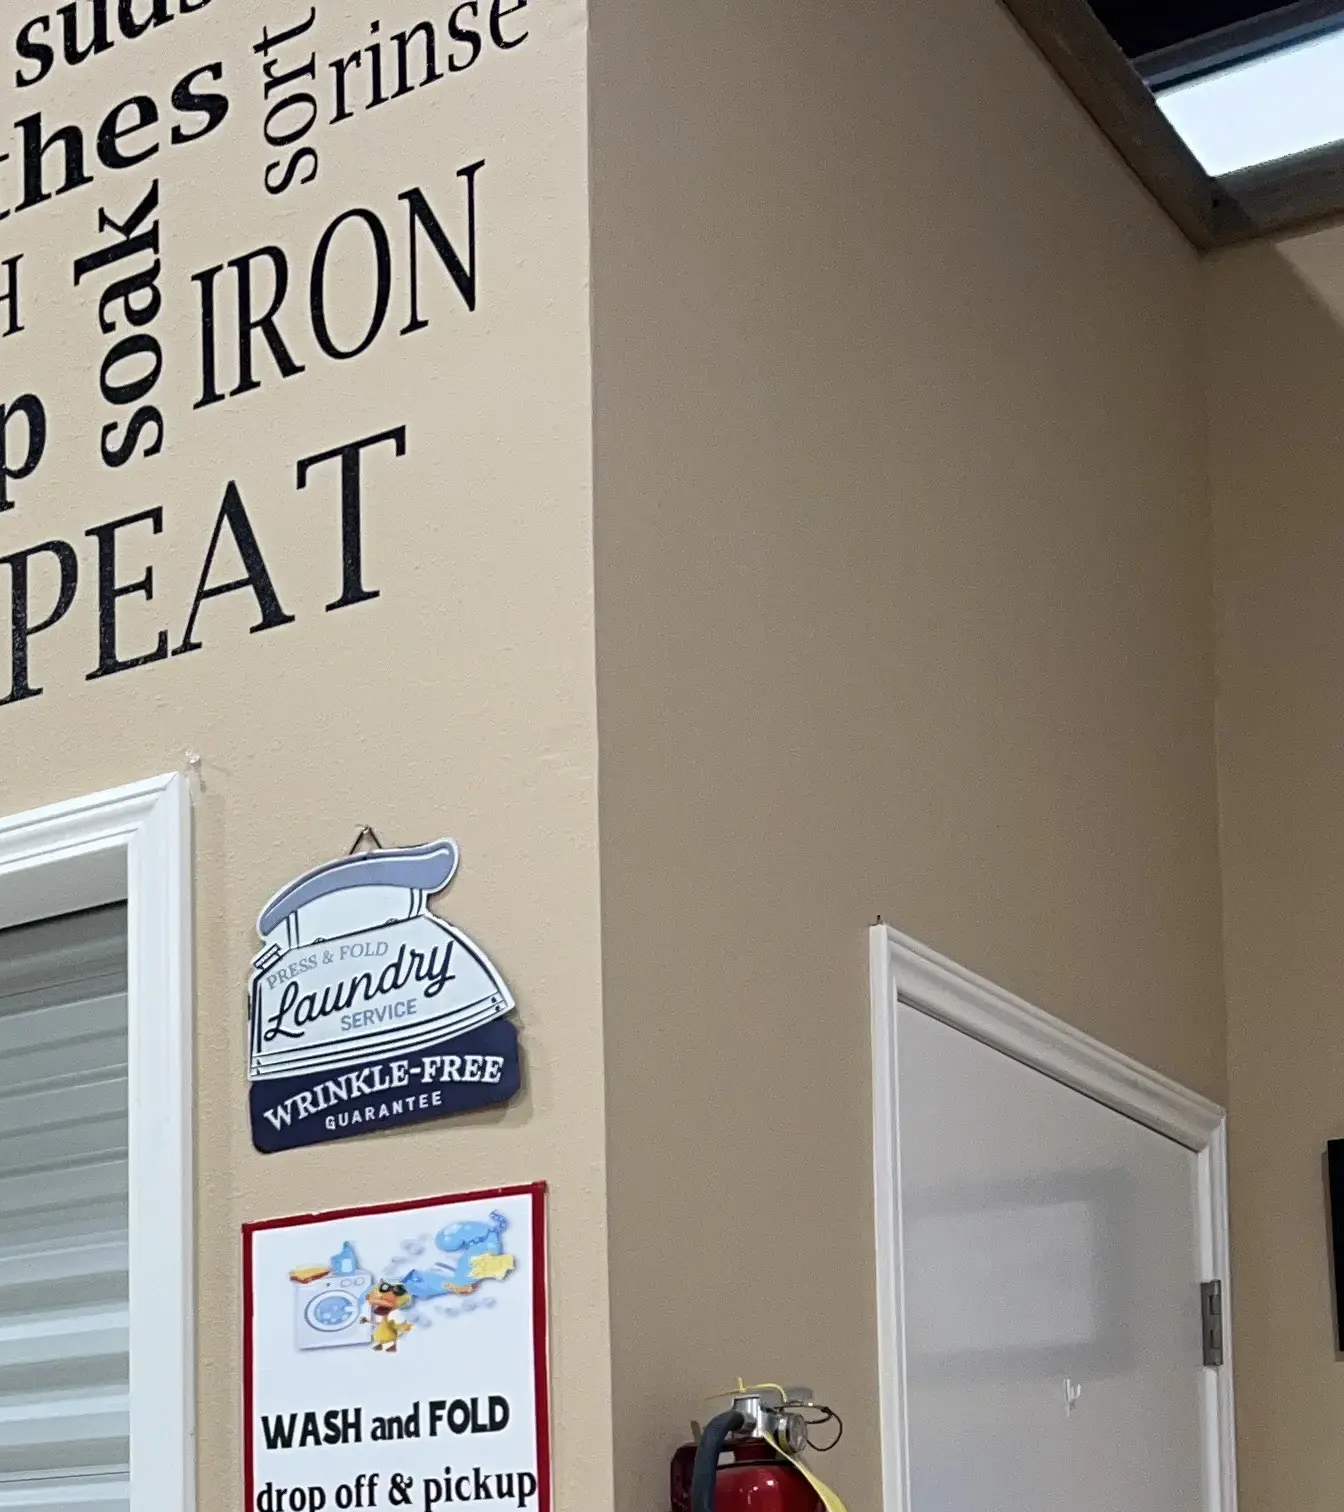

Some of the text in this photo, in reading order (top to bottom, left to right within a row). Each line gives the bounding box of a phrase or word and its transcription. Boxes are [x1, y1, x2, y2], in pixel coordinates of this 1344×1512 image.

[15, 0, 213, 88] su
[329, 0, 529, 125] rinse
[253, 3, 318, 195] sort
[74, 179, 164, 468] soak
[191, 160, 489, 410] IRON
[263, 940, 457, 1041] Laundry
[267, 941, 389, 991] PRESS & FOLD
[340, 998, 418, 1032] SERVICE
[263, 1055, 505, 1132] WRINKLE-FREE
[325, 1091, 443, 1130] GUARANTEE
[260, 1395, 510, 1450] WASH and FOLD
[334, 1473, 380, 1510] off
[388, 1472, 413, 1506] &
